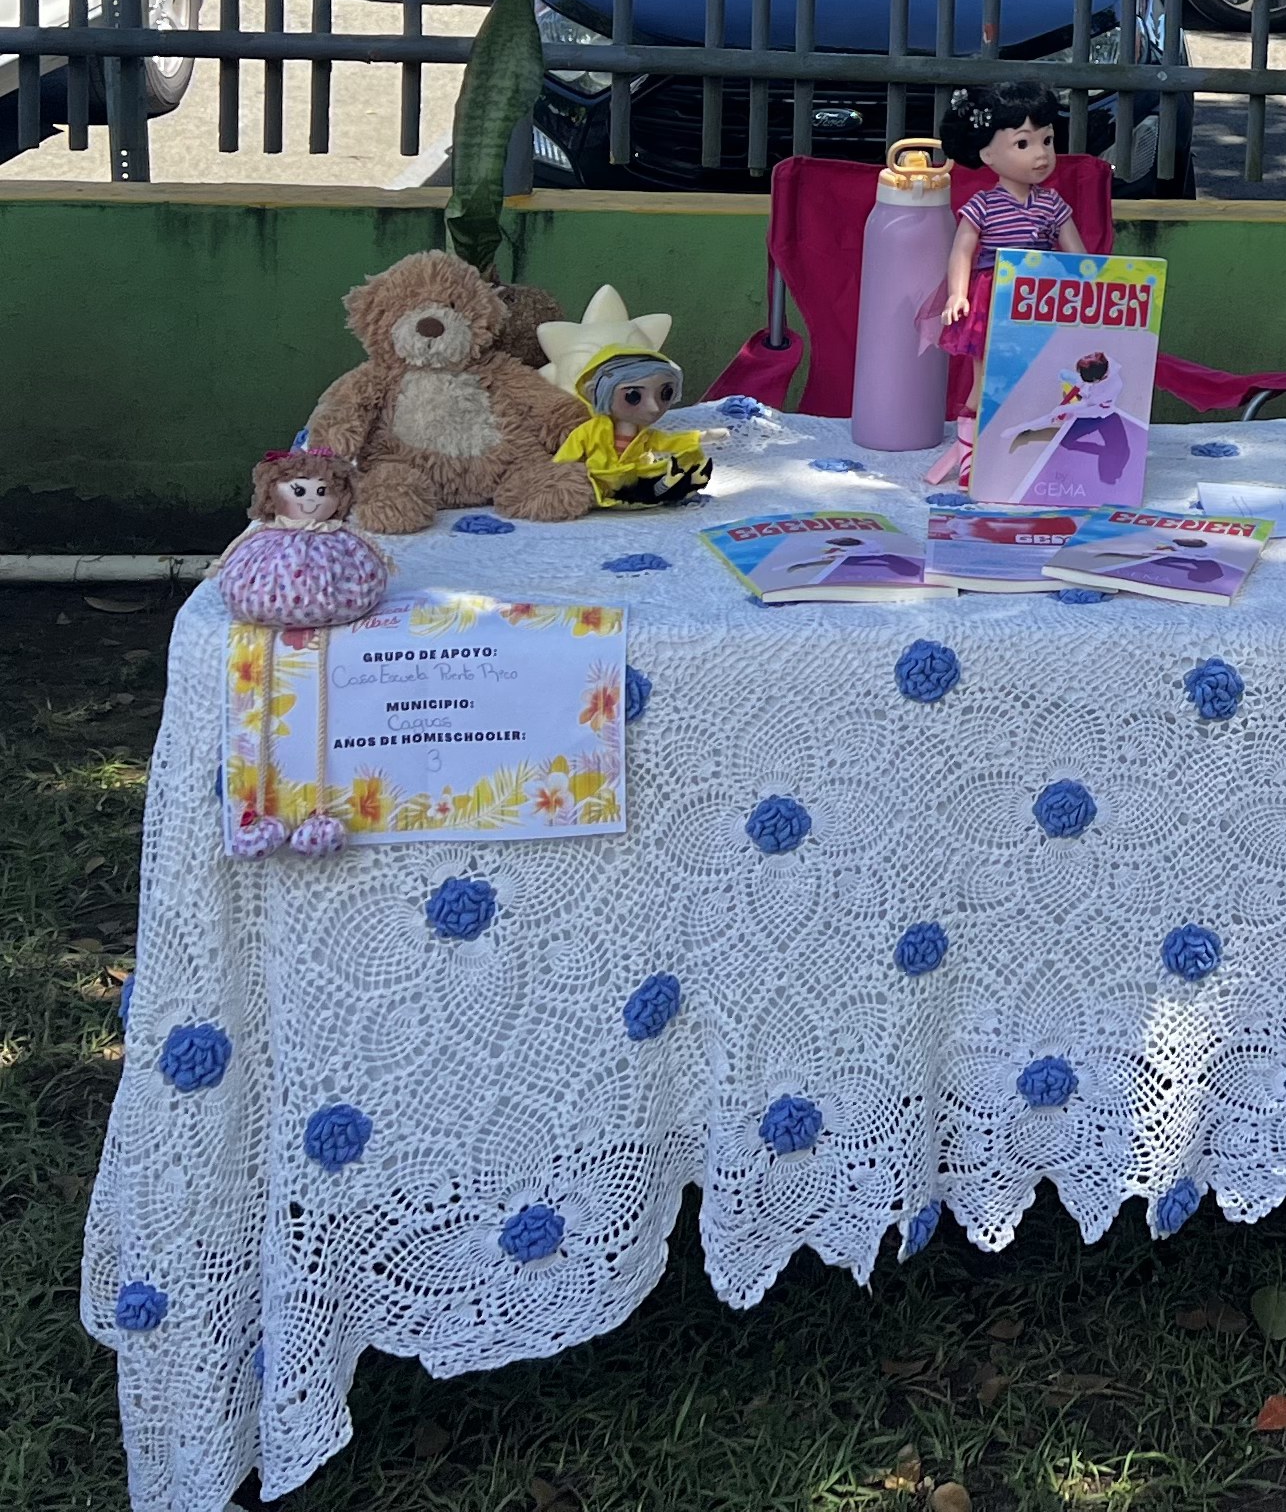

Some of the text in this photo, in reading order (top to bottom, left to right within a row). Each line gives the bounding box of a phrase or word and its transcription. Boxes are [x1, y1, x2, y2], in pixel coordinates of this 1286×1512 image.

[1010, 276, 1152, 329] ELEVEN
[1033, 481, 1087, 497] GEMA
[727, 517, 885, 542] ELEVEN
[1108, 510, 1257, 537] ELEVEN
[362, 646, 498, 663] GRUPO DE APOYO:
[386, 698, 475, 713] MUNICIPIO:
[387, 713, 453, 733] Caguas
[333, 730, 527, 749] AÑOS DE HOMESCHOOLER:
[426, 748, 443, 773] 3
